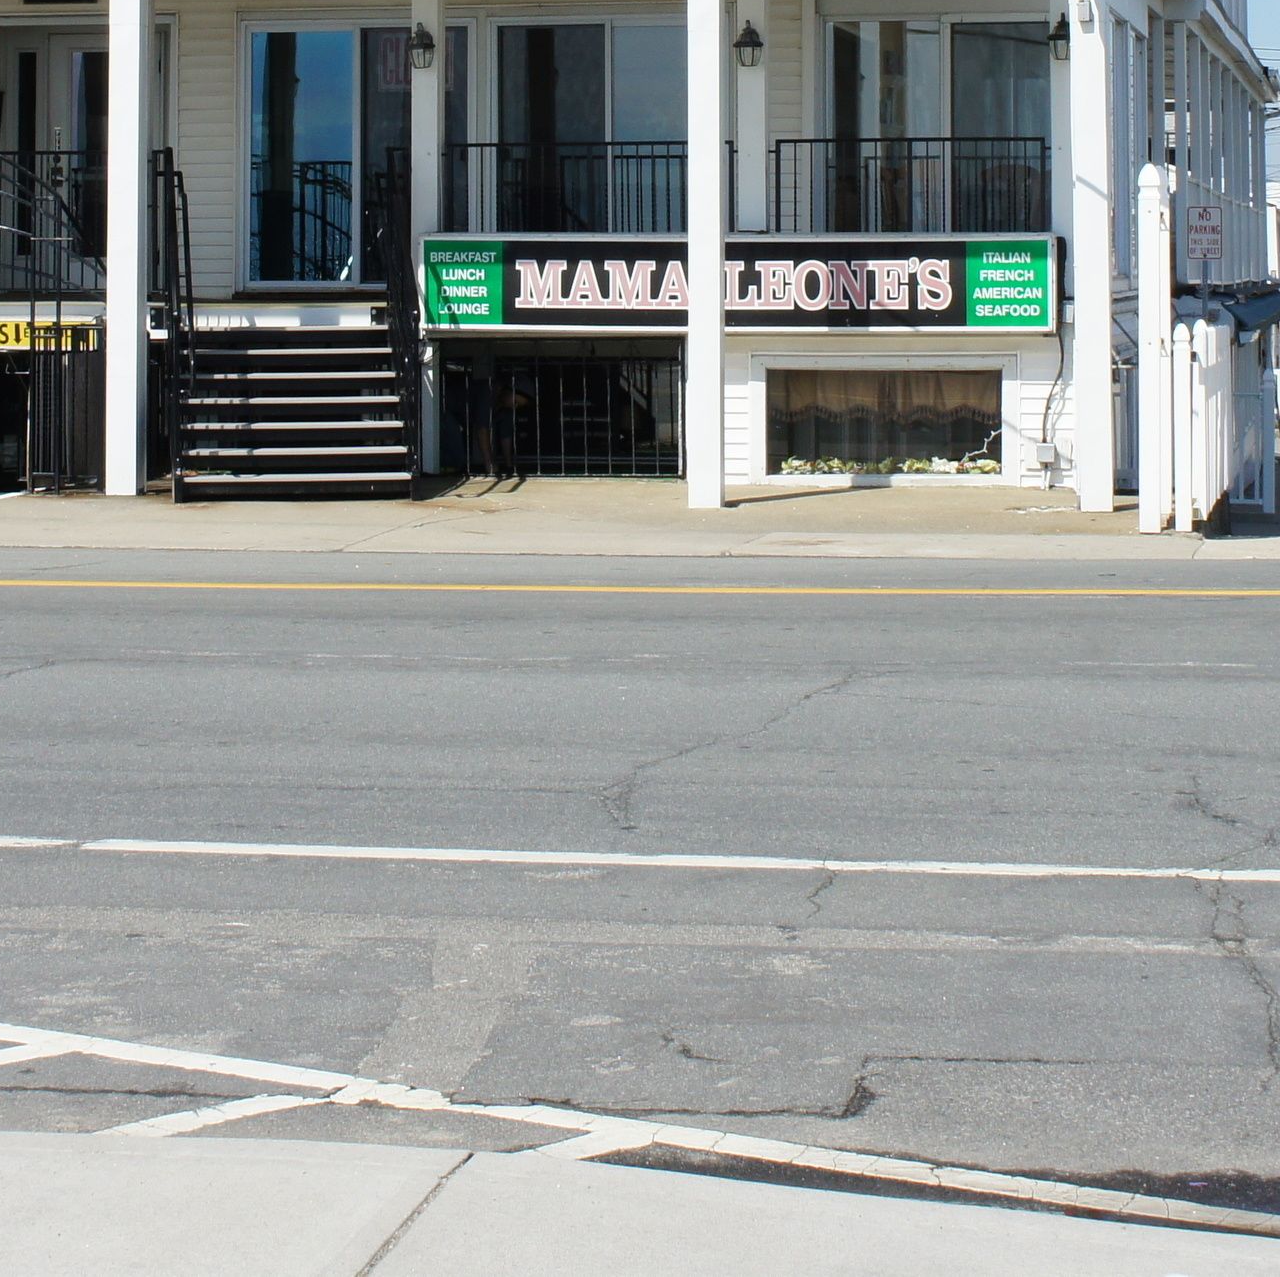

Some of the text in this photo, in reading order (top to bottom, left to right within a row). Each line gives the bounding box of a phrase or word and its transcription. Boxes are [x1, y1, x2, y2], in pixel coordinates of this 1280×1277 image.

[1198, 211, 1211, 221] NO
[1189, 225, 1221, 235] PARKING
[430, 252, 496, 263] BREAKFAST
[983, 252, 1031, 264] ITALIAN
[442, 269, 485, 281] LUNCH
[979, 269, 1034, 281] FRENCH
[515, 256, 953, 311] MAMA LEONE'S
[441, 286, 488, 298] DINNER
[973, 287, 1042, 299] AMERICAN
[438, 303, 490, 315] LOUNGE
[975, 304, 1041, 316] SEAFOOD
